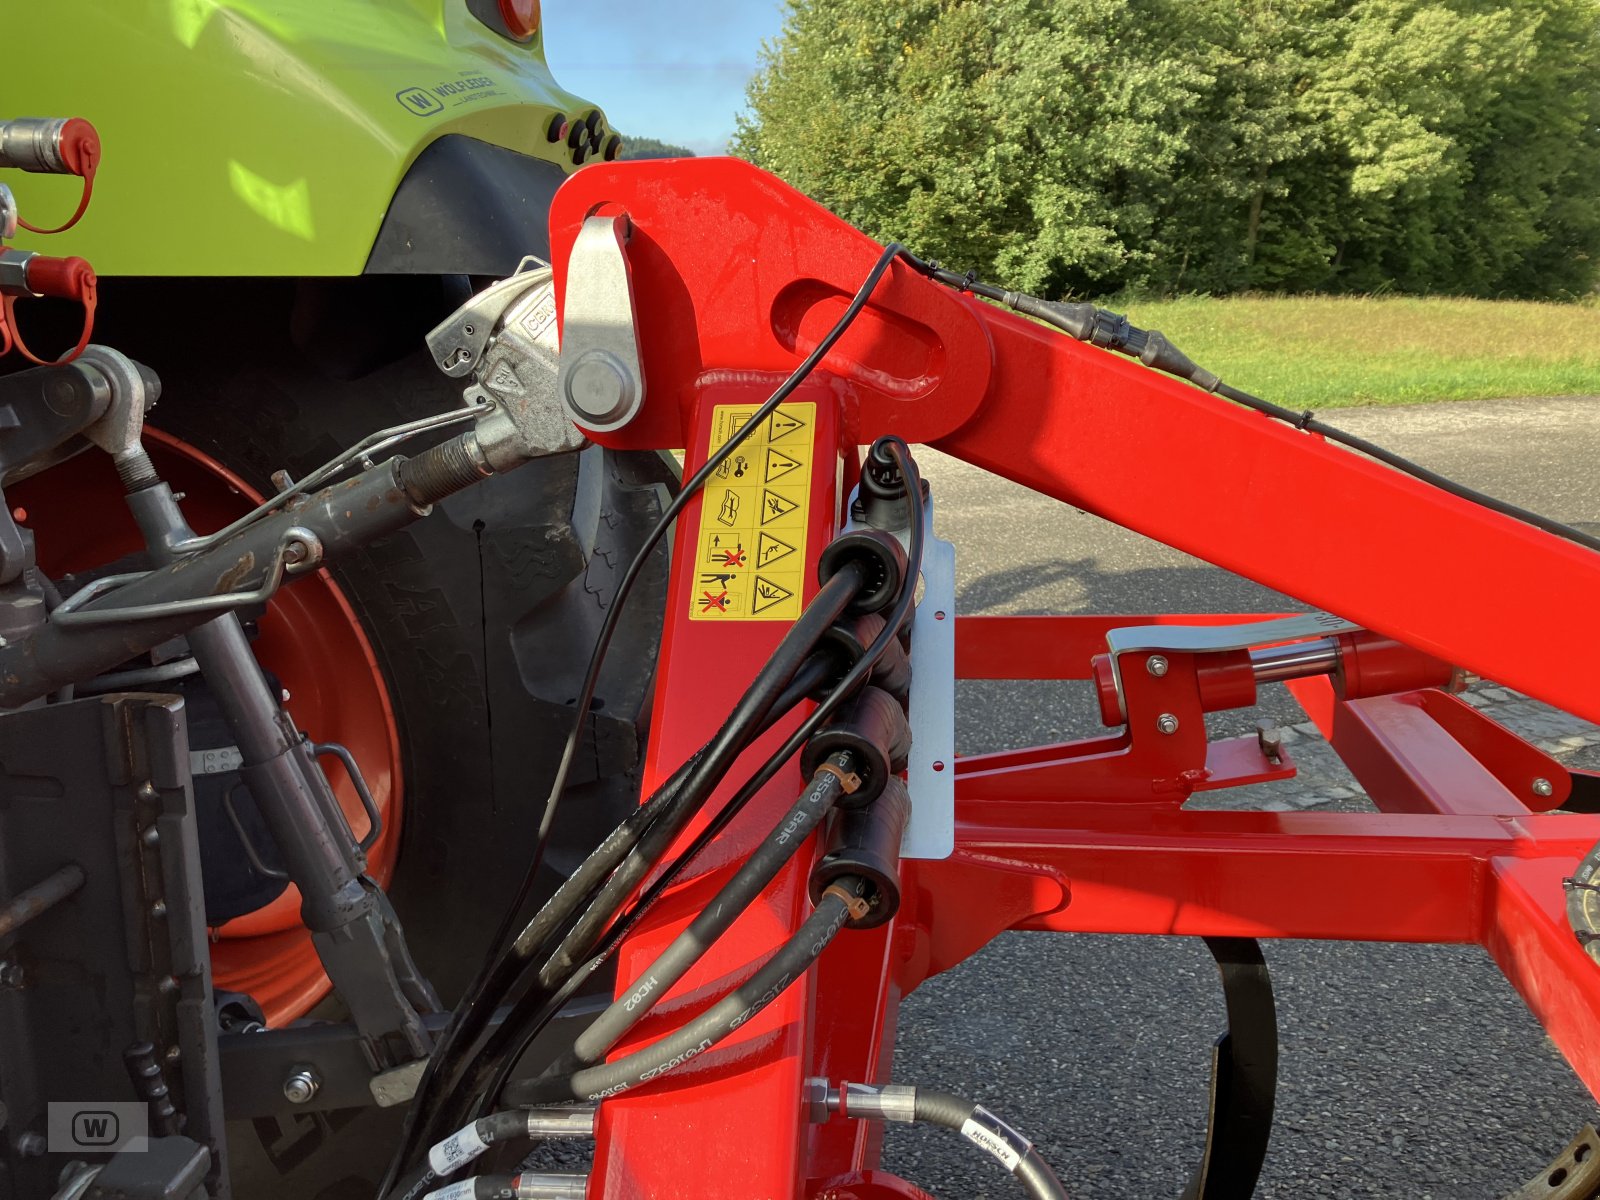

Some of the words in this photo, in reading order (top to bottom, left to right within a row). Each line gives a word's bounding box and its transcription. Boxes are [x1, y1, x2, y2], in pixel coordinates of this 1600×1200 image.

[406, 93, 432, 109] W
[809, 772, 836, 803] 350
[775, 810, 808, 845] BAR
